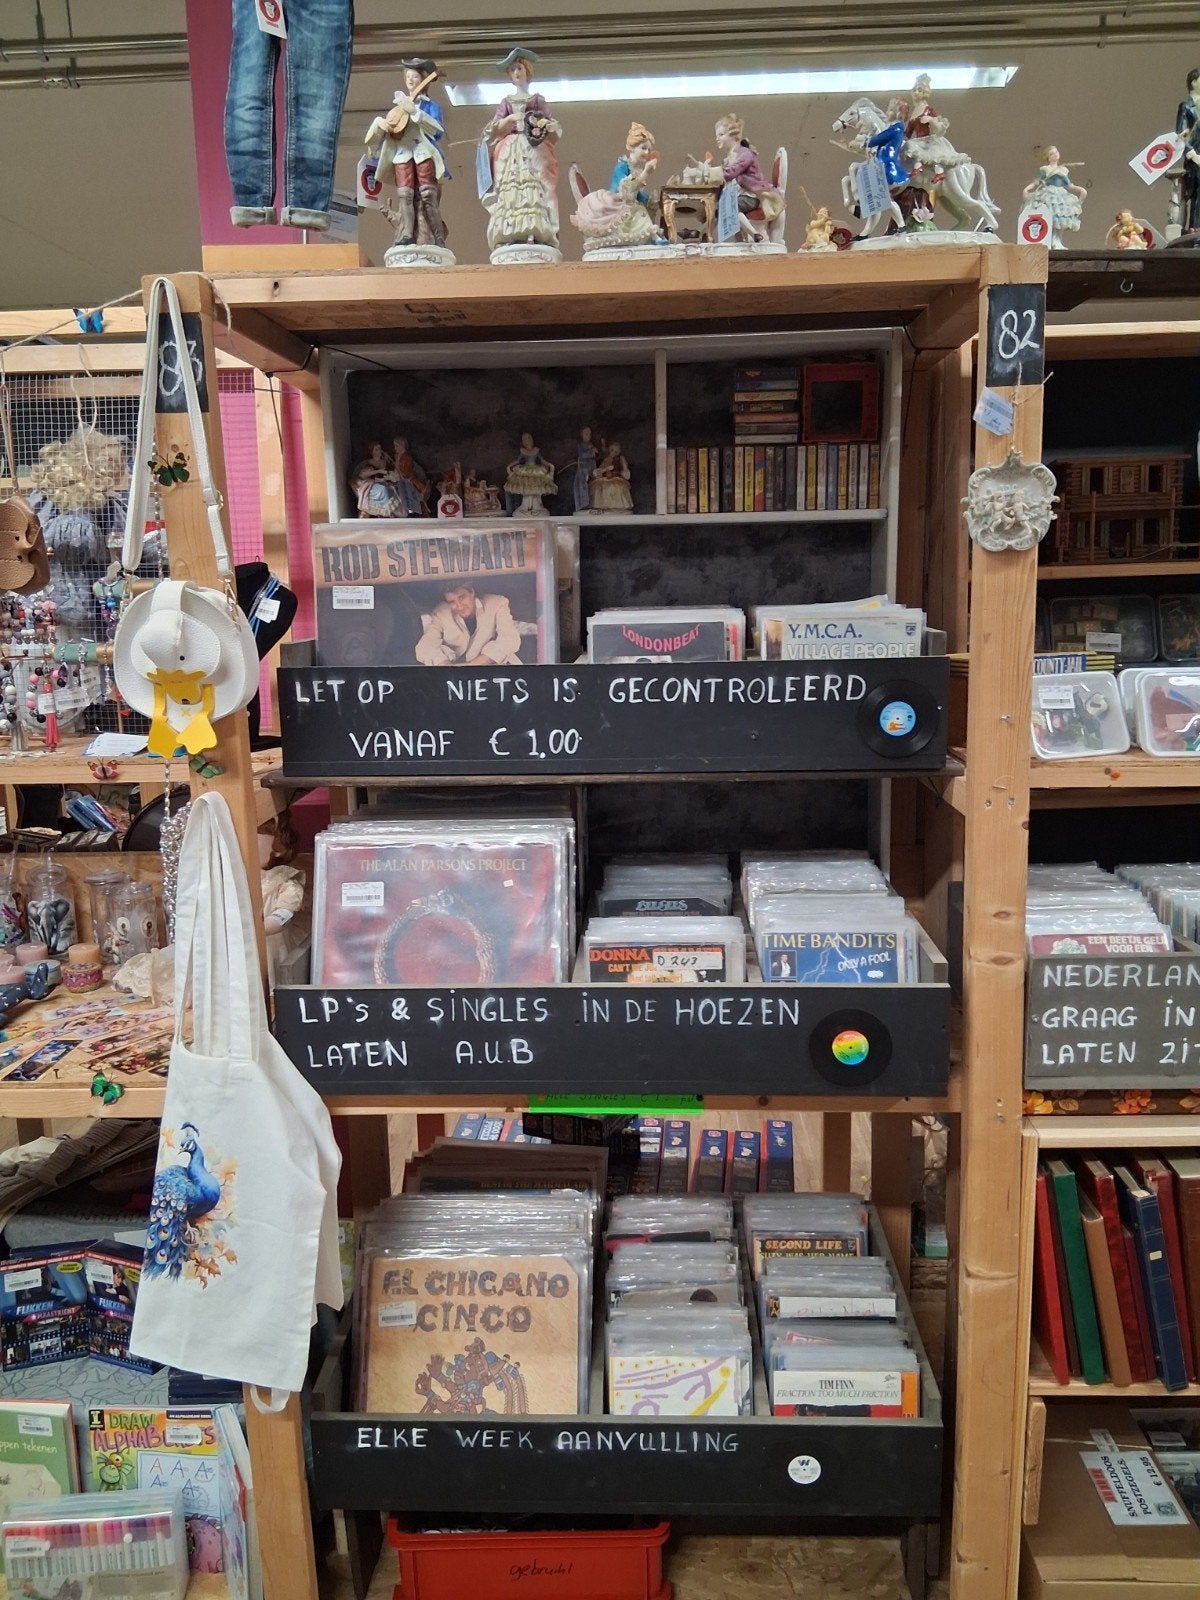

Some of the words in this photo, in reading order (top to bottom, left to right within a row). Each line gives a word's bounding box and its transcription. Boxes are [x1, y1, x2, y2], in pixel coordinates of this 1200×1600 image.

[999, 310, 1040, 359] 82
[321, 543, 381, 582] ROD
[387, 530, 527, 578] STEWART
[621, 624, 700, 653] LONDONBEAT
[788, 623, 863, 640] Y.M.C.A.
[786, 643, 852, 659] VILLAGE
[853, 643, 916, 658] PEOPLE
[296, 680, 345, 703] LET
[357, 679, 395, 703] OP
[446, 677, 530, 703] NIETS
[553, 677, 579, 702] IS
[608, 674, 867, 703] GECONTROLEERD
[349, 729, 455, 758] VANAF
[359, 859, 381, 871] THE
[384, 859, 417, 871] ALAN
[421, 859, 475, 872] PARSONS
[478, 859, 527, 872] PROJECT
[763, 933, 806, 949] TIME
[810, 932, 897, 949] BANDITS
[1105, 944, 1132, 953] VOOR
[1134, 944, 1153, 953] EEN
[589, 948, 650, 962] DONNA
[837, 958, 859, 973] ONLY
[868, 951, 892, 964] FOOL
[391, 997, 411, 1021] &
[625, 999, 656, 1023] DE
[675, 998, 800, 1026] HOEZEN
[1041, 1006, 1138, 1028] GRAAG
[308, 1040, 408, 1067] LATEN
[1041, 1041, 1137, 1065] LATEN
[765, 1240, 812, 1250] SECOND
[815, 1240, 842, 1250] LIFE
[382, 1269, 418, 1296] EL
[424, 1269, 570, 1299] CHICANO
[16, 1301, 54, 1316] FLIKKEN
[414, 1301, 532, 1333] CINCO
[776, 1389, 815, 1398] FRACTION
[817, 1389, 835, 1398] TOO
[836, 1389, 860, 1398] MUCH
[861, 1390, 899, 1398] FRICTION
[819, 1379, 834, 1389] TIM
[836, 1379, 855, 1389] FINN
[109, 1412, 156, 1430] DRAW
[21, 1438, 58, 1454] tekenen
[357, 1427, 428, 1448] ELKE
[456, 1429, 533, 1449] WEEK
[557, 1430, 739, 1453] AANVULLING
[1101, 1456, 1138, 1518] SNUFFELDOOS
[1117, 1458, 1152, 1516] POSTZEGELS
